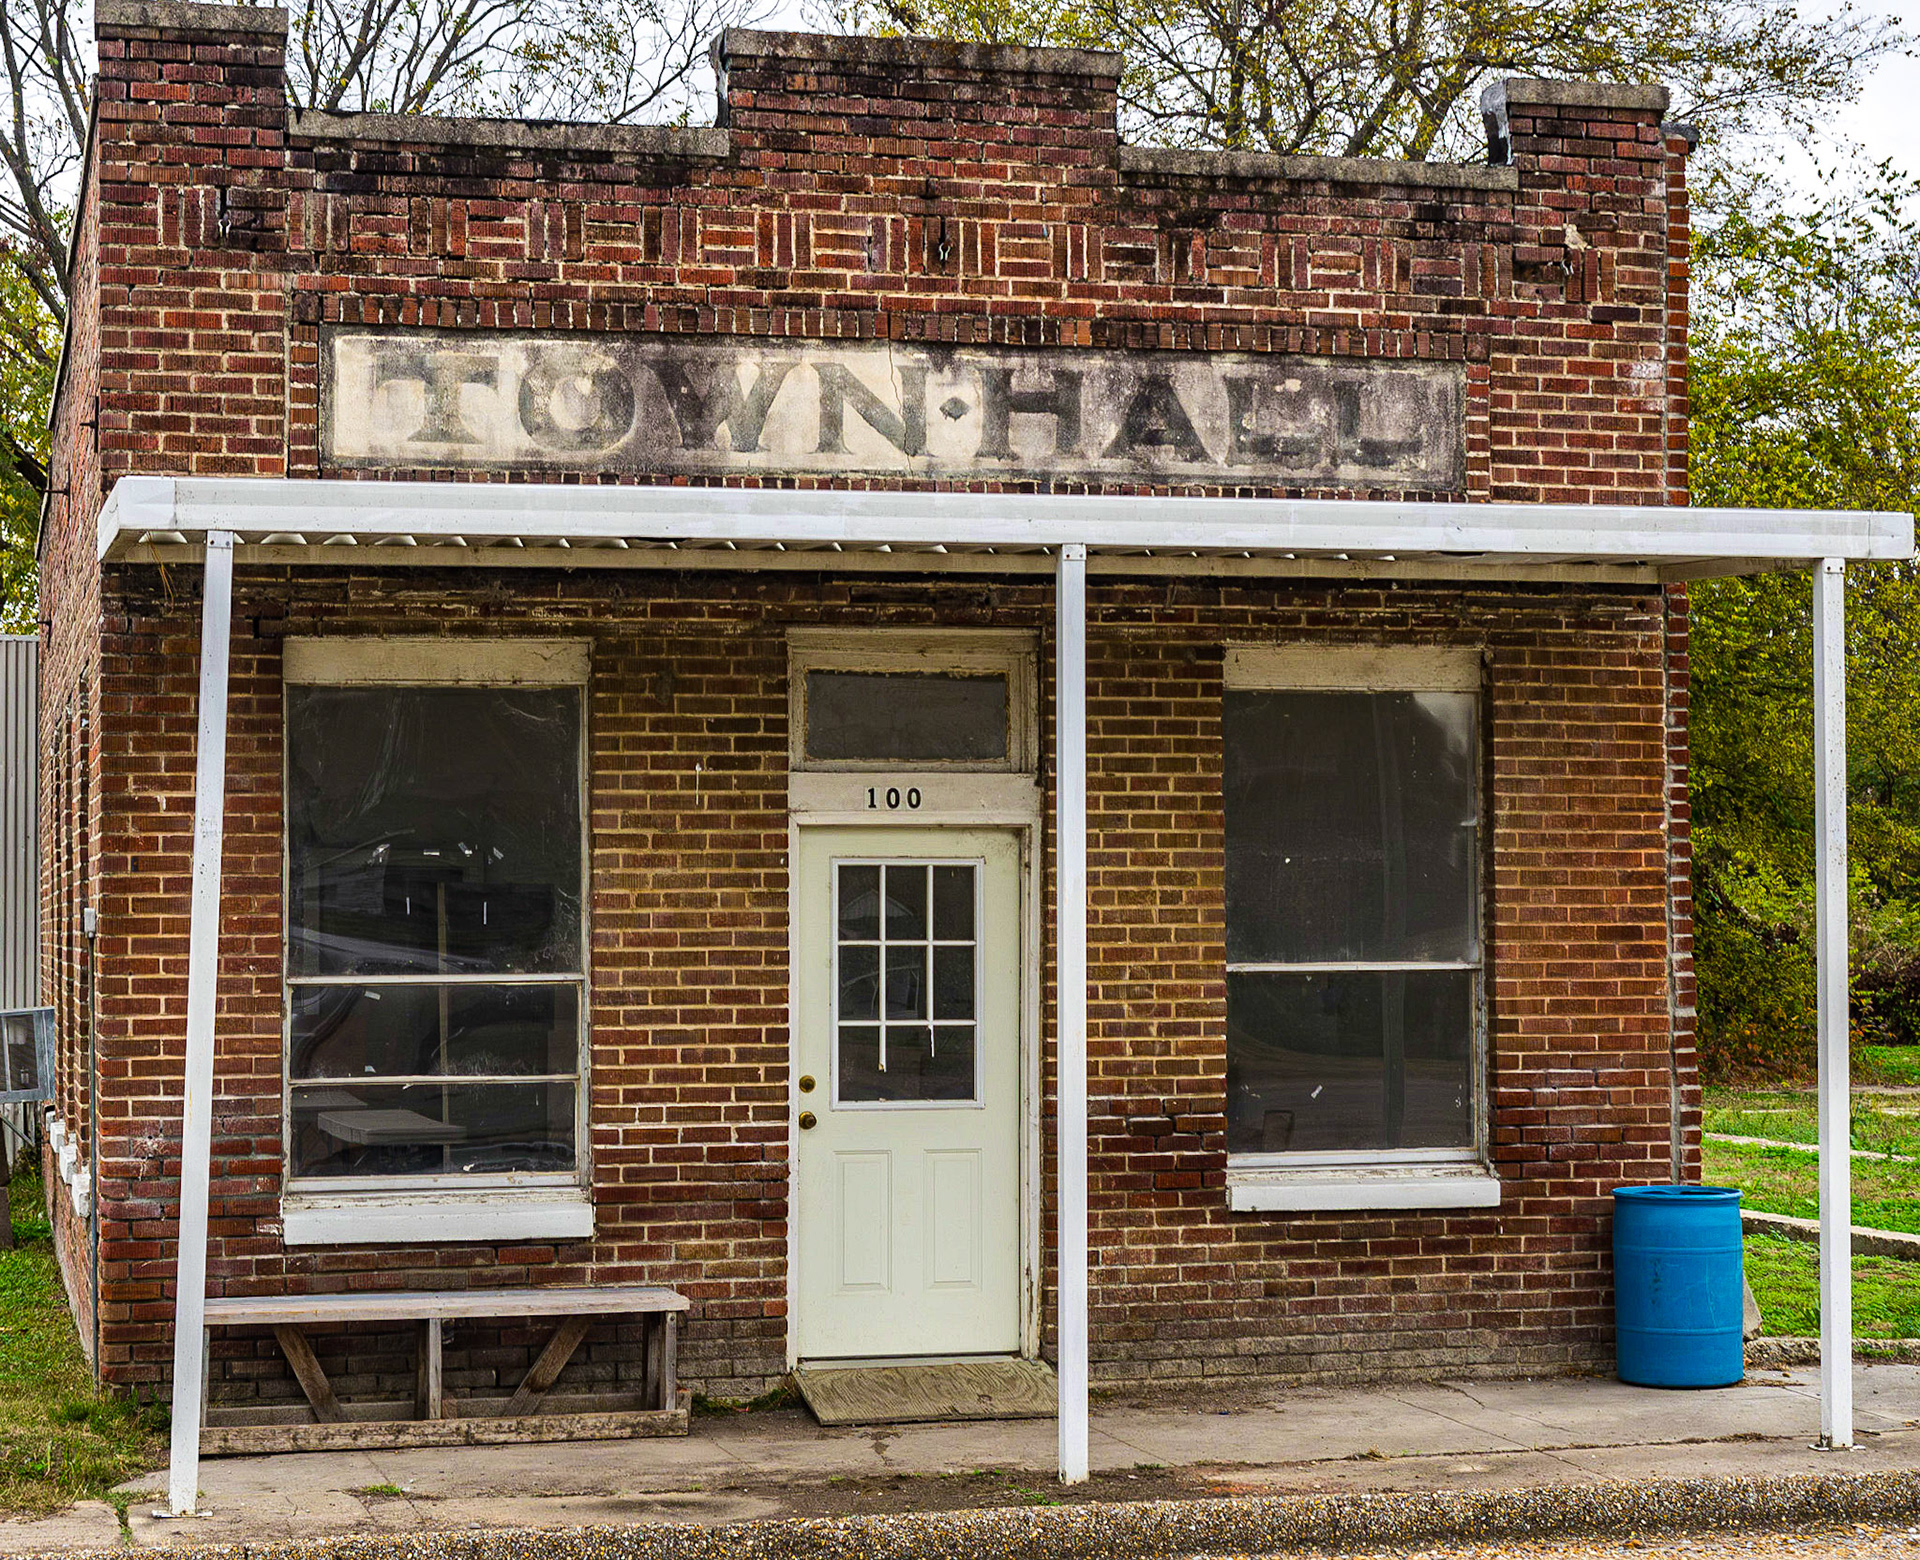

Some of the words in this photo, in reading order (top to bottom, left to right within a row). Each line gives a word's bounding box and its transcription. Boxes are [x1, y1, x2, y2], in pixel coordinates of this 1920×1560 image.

[376, 353, 928, 457] TOWN
[973, 366, 1430, 472] HALL
[867, 787, 922, 809] 100
